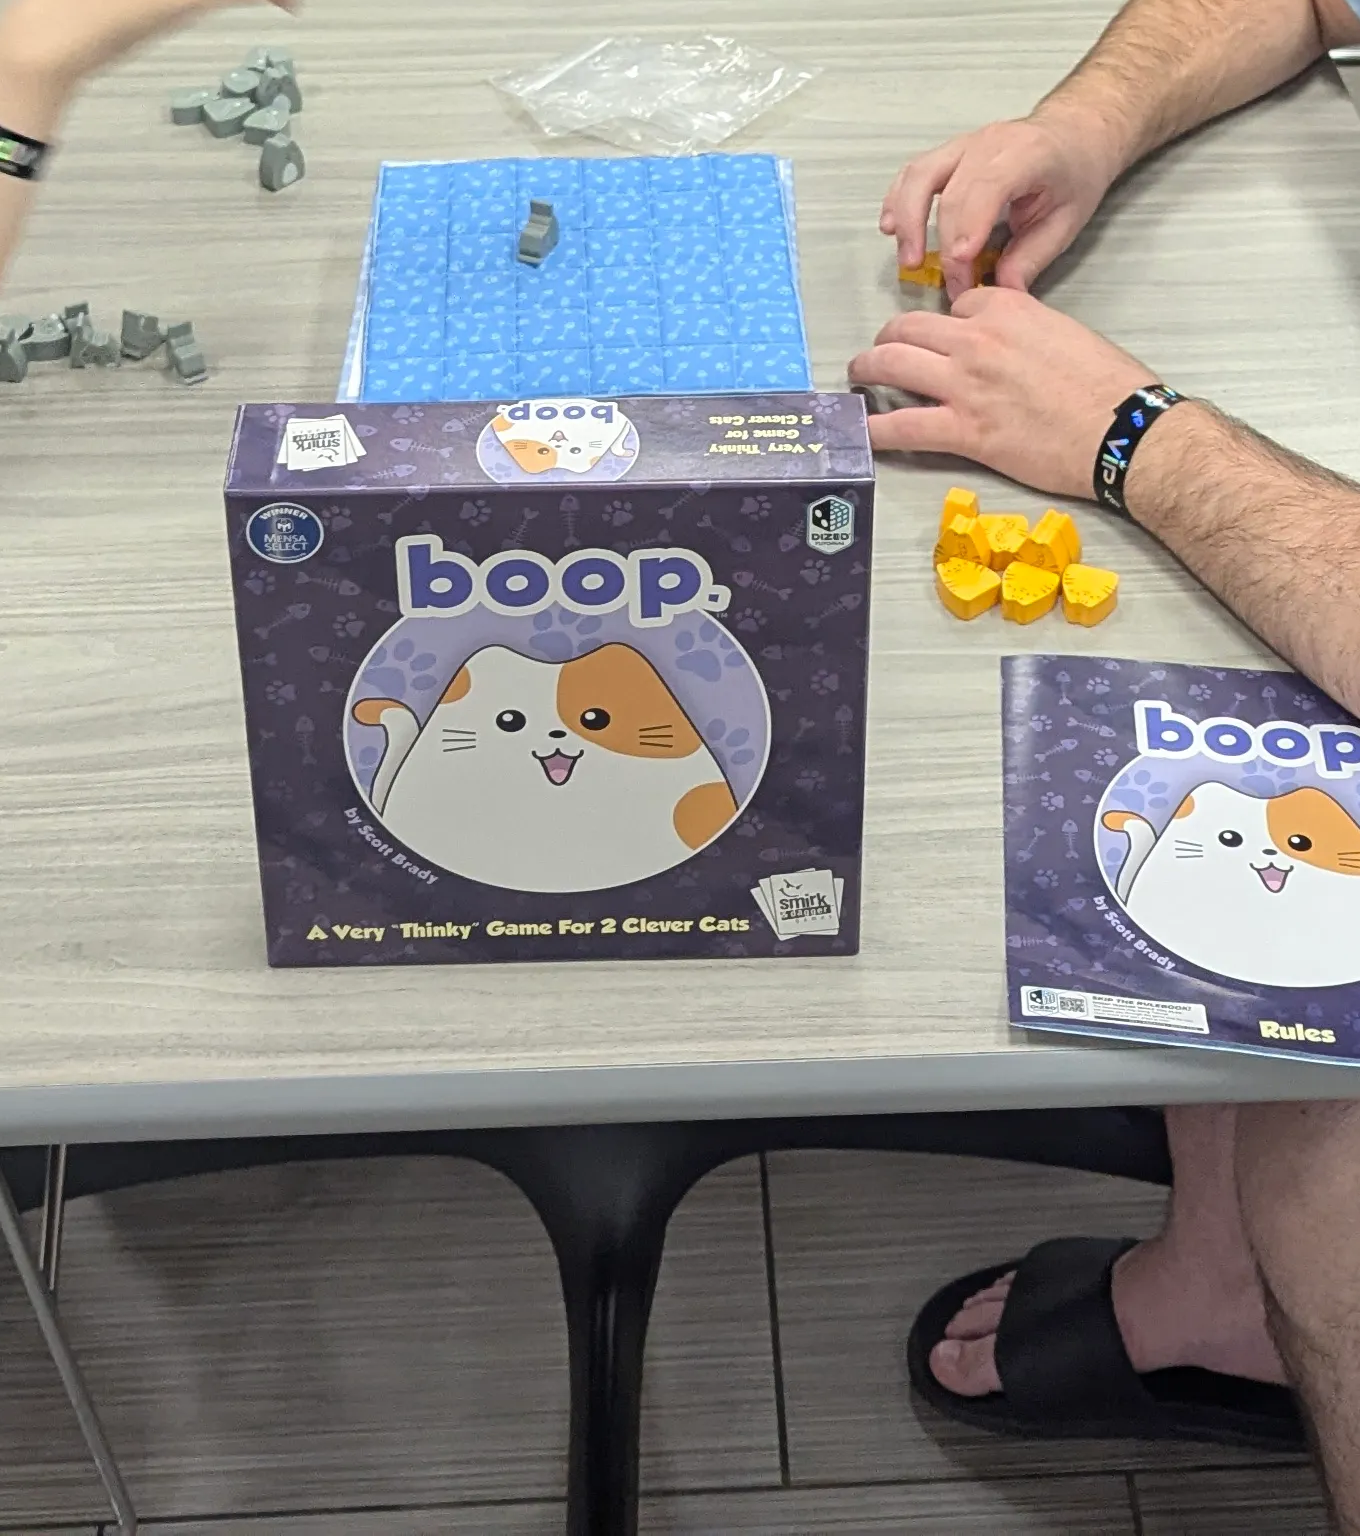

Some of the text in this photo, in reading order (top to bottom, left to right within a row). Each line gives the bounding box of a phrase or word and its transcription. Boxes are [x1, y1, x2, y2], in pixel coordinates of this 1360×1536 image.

[708, 414, 814, 426] 2 Clever Cats
[752, 429, 800, 440] Game
[295, 437, 341, 452] smirk
[767, 442, 806, 454] Very
[808, 443, 824, 454] A
[1102, 438, 1129, 484] VIP
[258, 507, 309, 521] WINNER
[811, 532, 850, 541] DIZED
[264, 542, 309, 551] SELECT
[343, 807, 439, 885] by Scott Brady
[779, 892, 828, 910] smirk
[789, 906, 829, 918] dagger
[306, 924, 329, 940] A
[331, 923, 386, 942] Very
[485, 920, 553, 937] Game
[558, 919, 595, 935] For
[600, 917, 617, 934] 2
[621, 917, 694, 934] Clever
[698, 916, 750, 932] Cats
[1092, 895, 1176, 970] by Scott Brady
[1258, 1020, 1337, 1043] Rules
